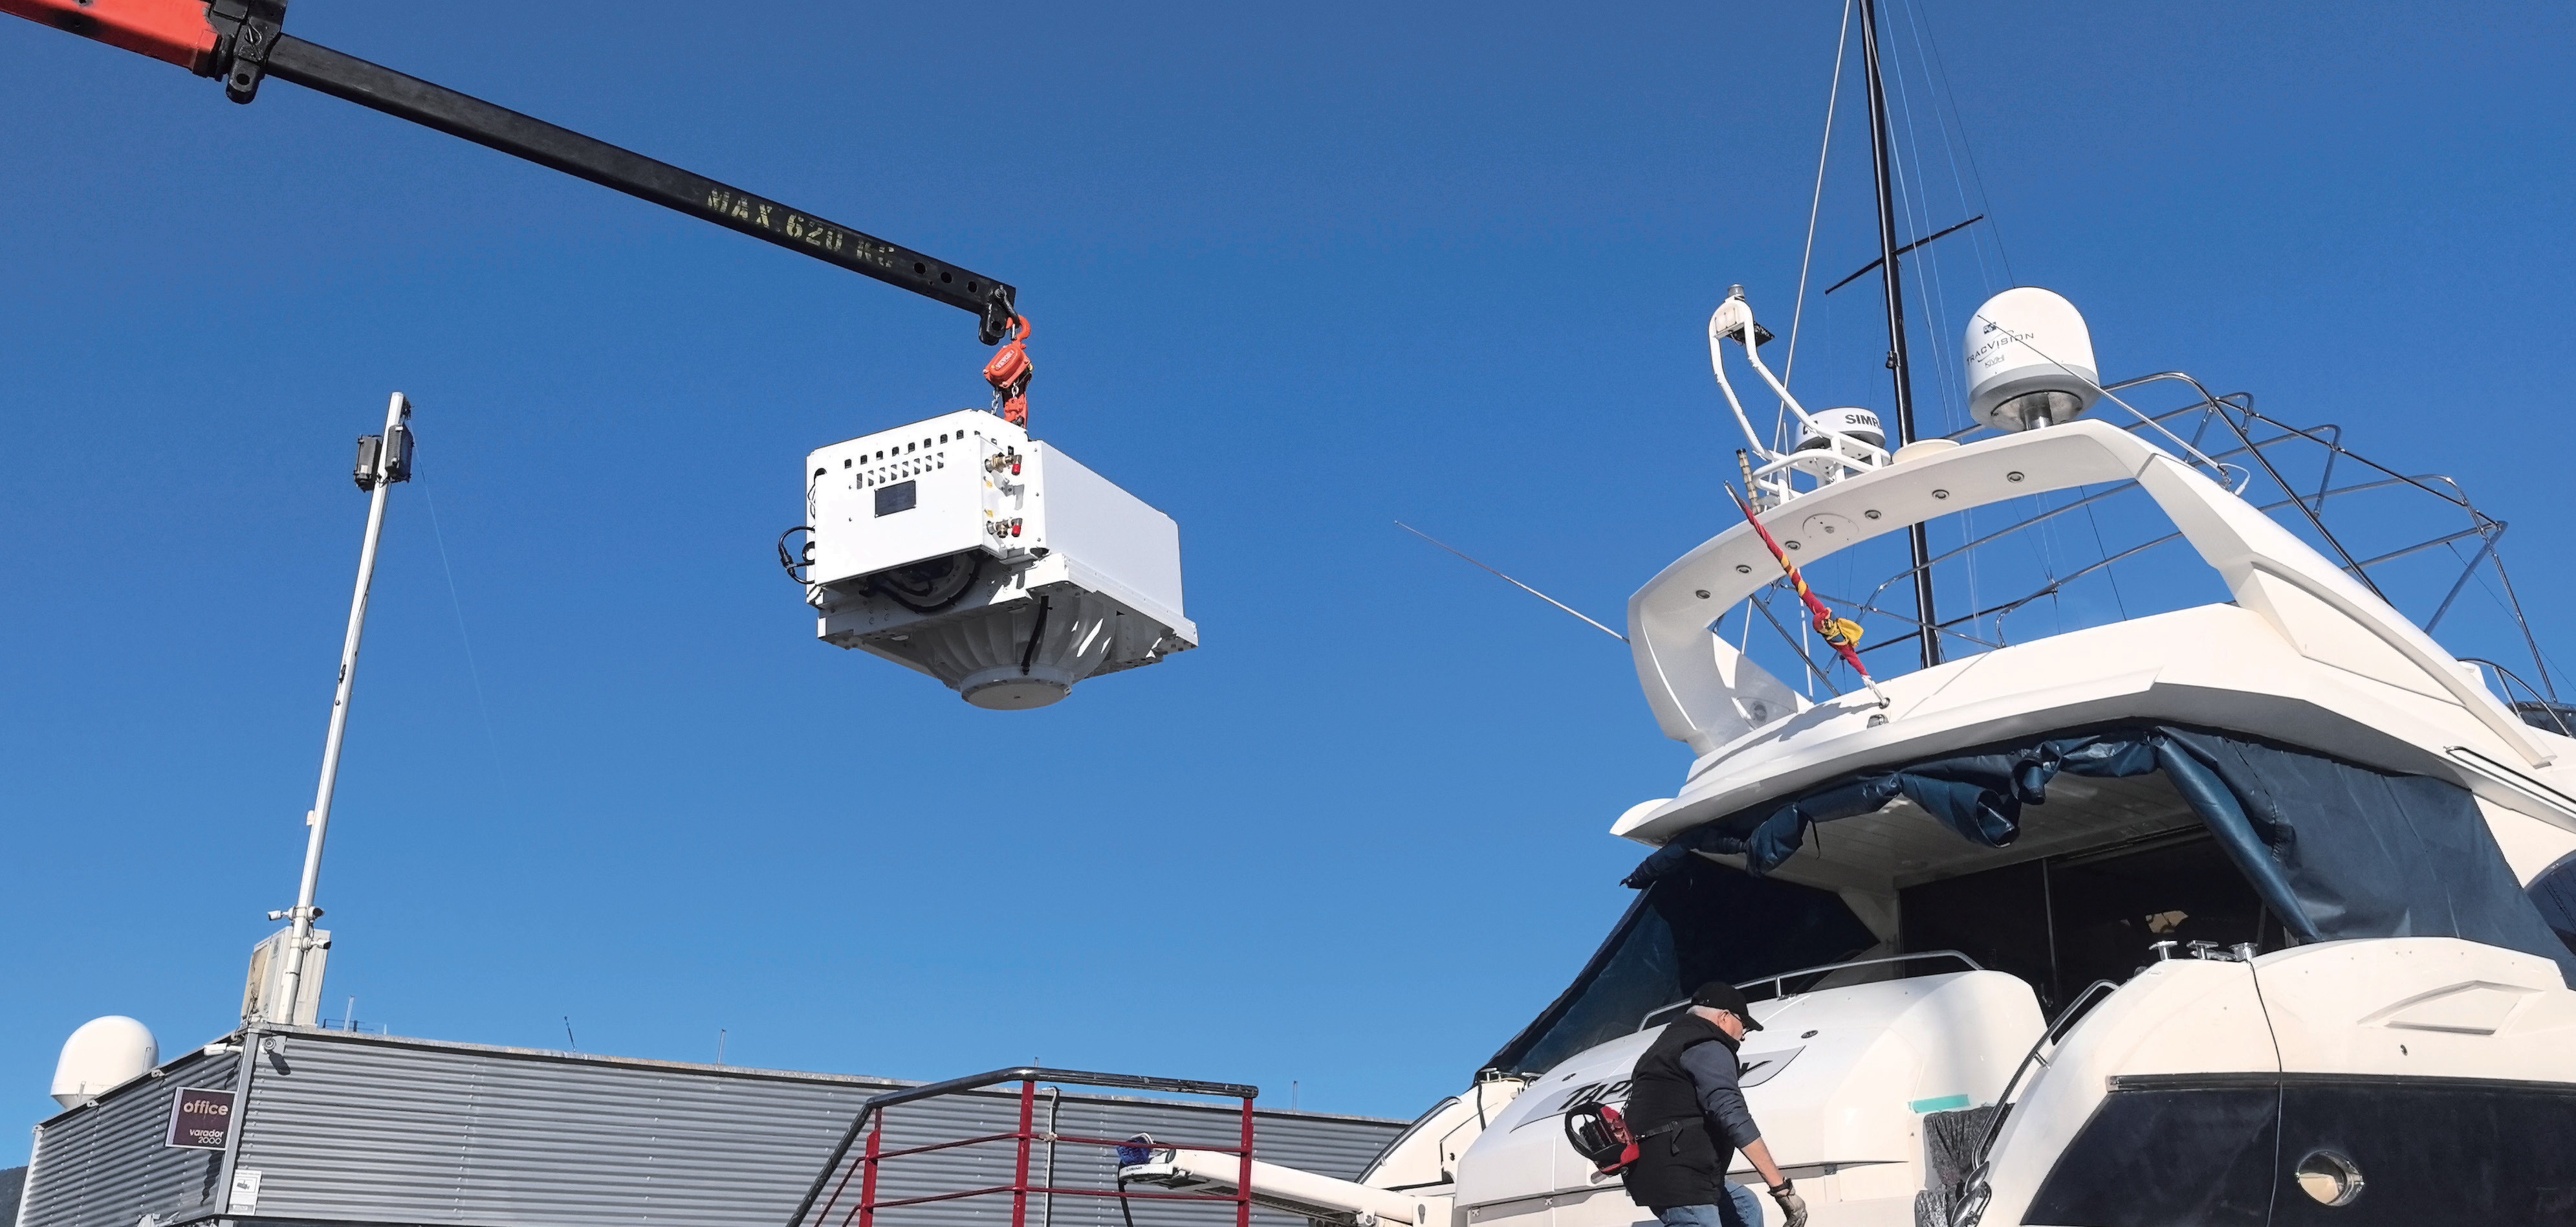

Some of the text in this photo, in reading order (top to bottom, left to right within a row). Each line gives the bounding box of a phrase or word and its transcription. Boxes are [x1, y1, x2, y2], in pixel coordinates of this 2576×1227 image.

[786, 214, 843, 252] 620
[1845, 414, 1882, 429] SIMR
[183, 1100, 229, 1116] office
[189, 1129, 224, 1138] varador
[198, 1136, 222, 1145] 2000
